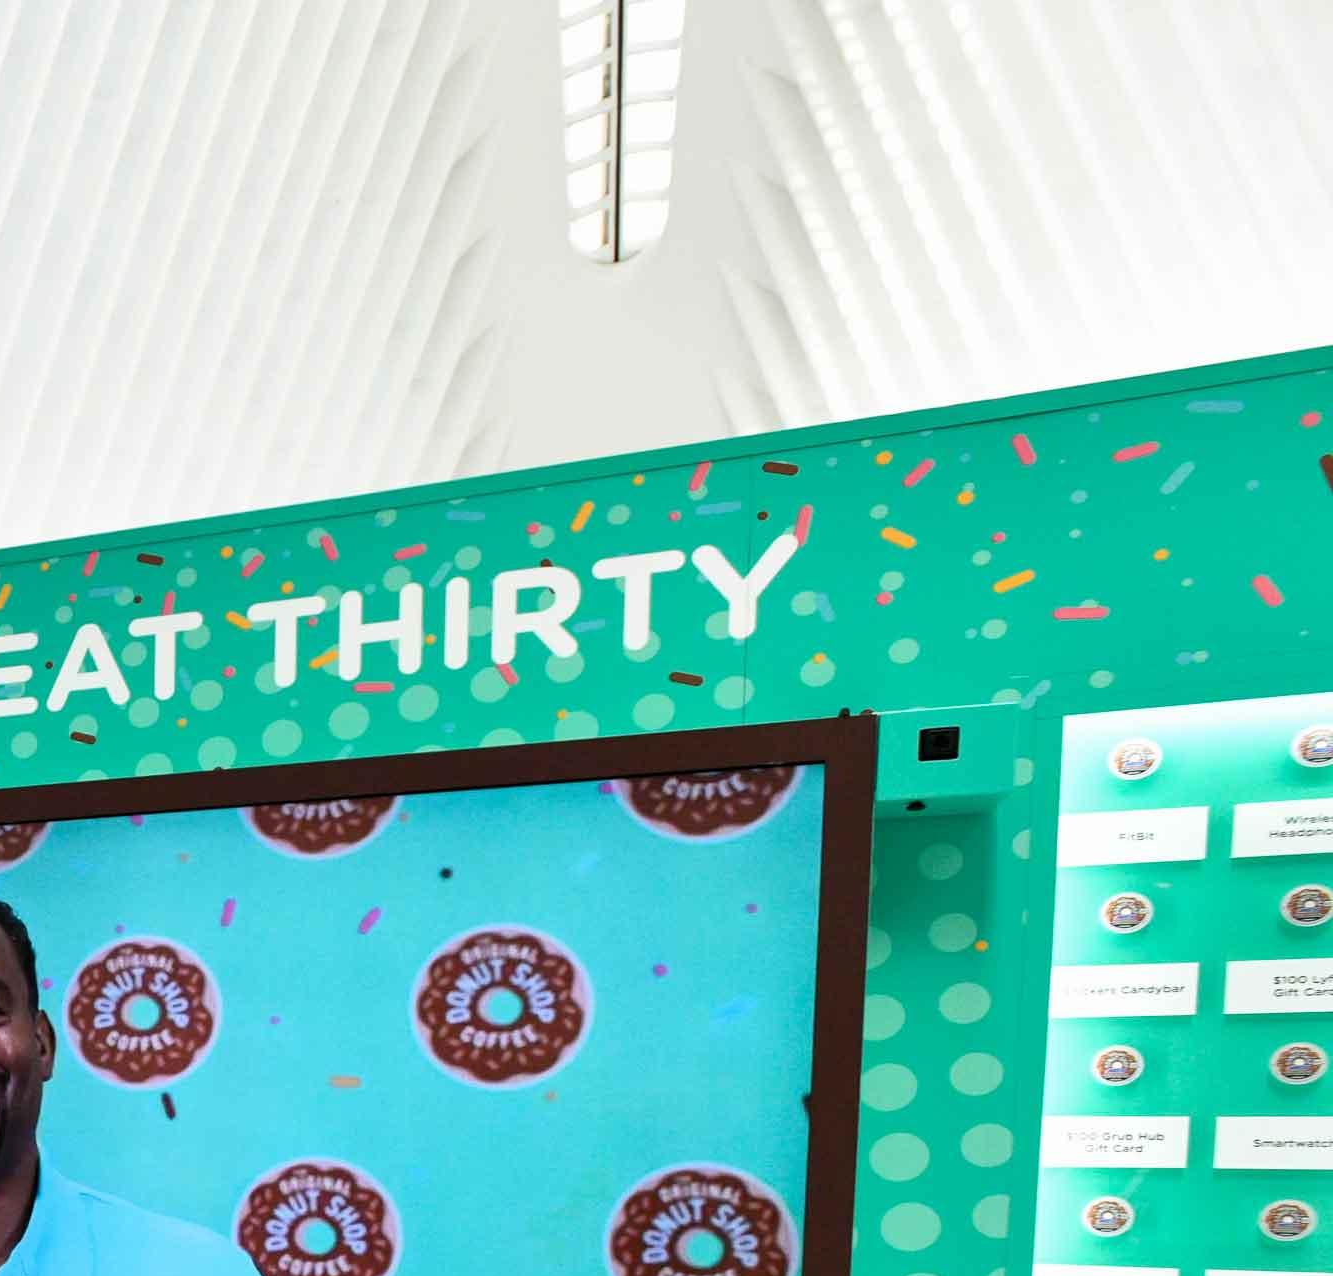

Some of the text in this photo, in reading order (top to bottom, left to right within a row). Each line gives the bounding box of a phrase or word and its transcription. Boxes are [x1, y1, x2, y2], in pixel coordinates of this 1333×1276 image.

[249, 534, 798, 686] THIRTY
[662, 773, 747, 801] COFFEE
[94, 967, 191, 1029] DONUT SHOP
[446, 959, 556, 1024] DONUT SHOP
[1120, 985, 1186, 996] Candybar
[105, 1028, 176, 1052] COFFEE
[460, 1024, 537, 1049] COFFEE
[1102, 1131, 1134, 1141] Grub
[1138, 1132, 1166, 1141] Hub
[1112, 1143, 1144, 1153] Card
[265, 1189, 368, 1255] DONUT SHOP
[641, 1198, 759, 1268] DONUT SHOP
[278, 1253, 351, 1276] COFFEE
